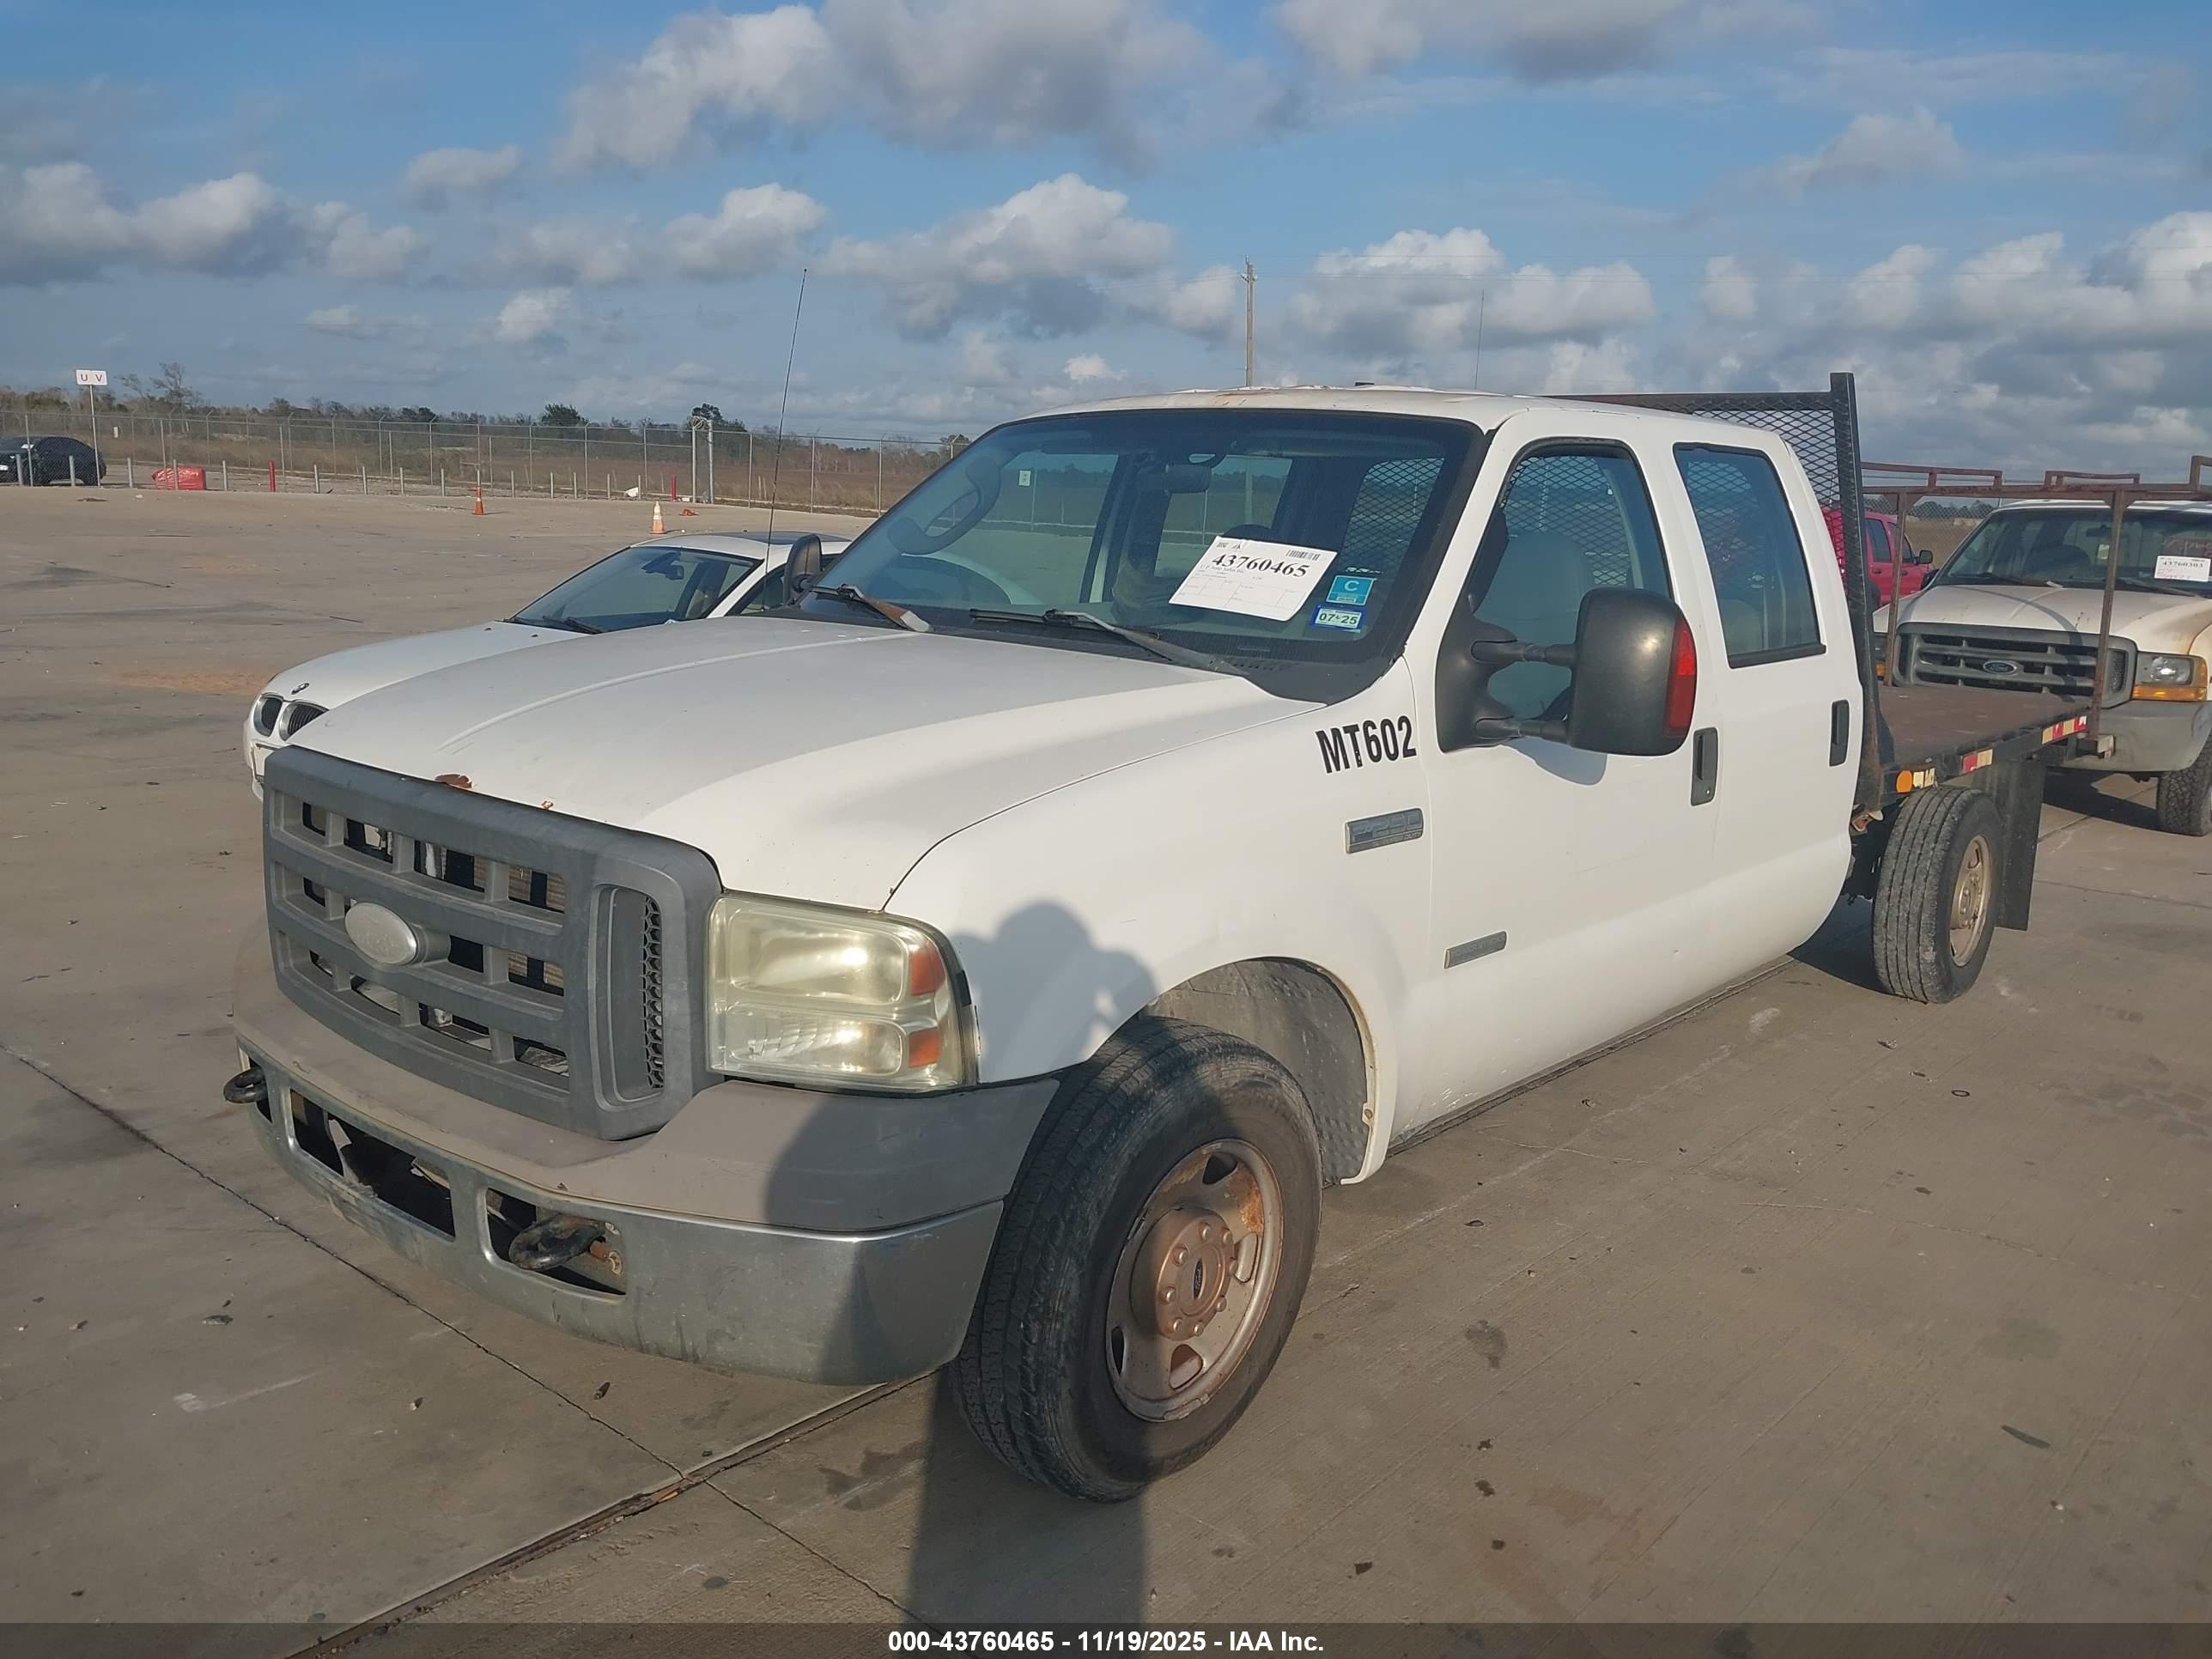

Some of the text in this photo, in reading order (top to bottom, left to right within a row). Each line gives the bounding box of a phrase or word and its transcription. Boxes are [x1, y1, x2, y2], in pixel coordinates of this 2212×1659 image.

[1212, 554, 1310, 578] 43760465
[1344, 580, 1360, 592] C
[1319, 612, 1358, 625] 07 25
[1315, 715, 1417, 774] MT602
